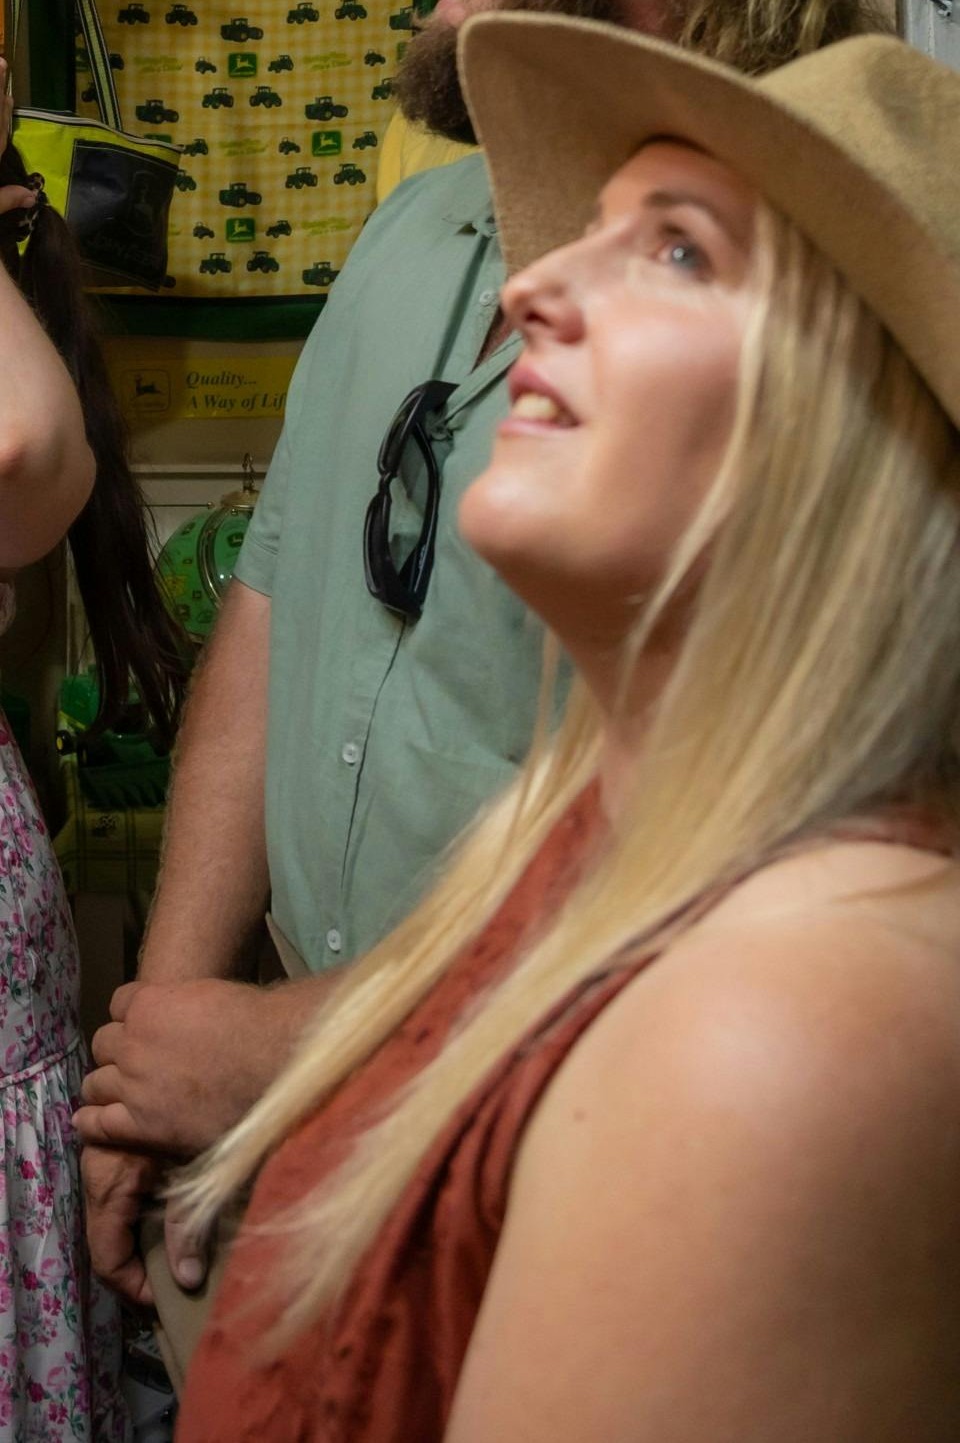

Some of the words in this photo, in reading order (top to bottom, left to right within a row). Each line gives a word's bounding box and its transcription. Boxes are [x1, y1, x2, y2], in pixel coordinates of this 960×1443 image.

[185, 371, 257, 390] Quality...
[203, 393, 238, 413] Way
[240, 392, 261, 412] of
[261, 392, 288, 411] Lif
